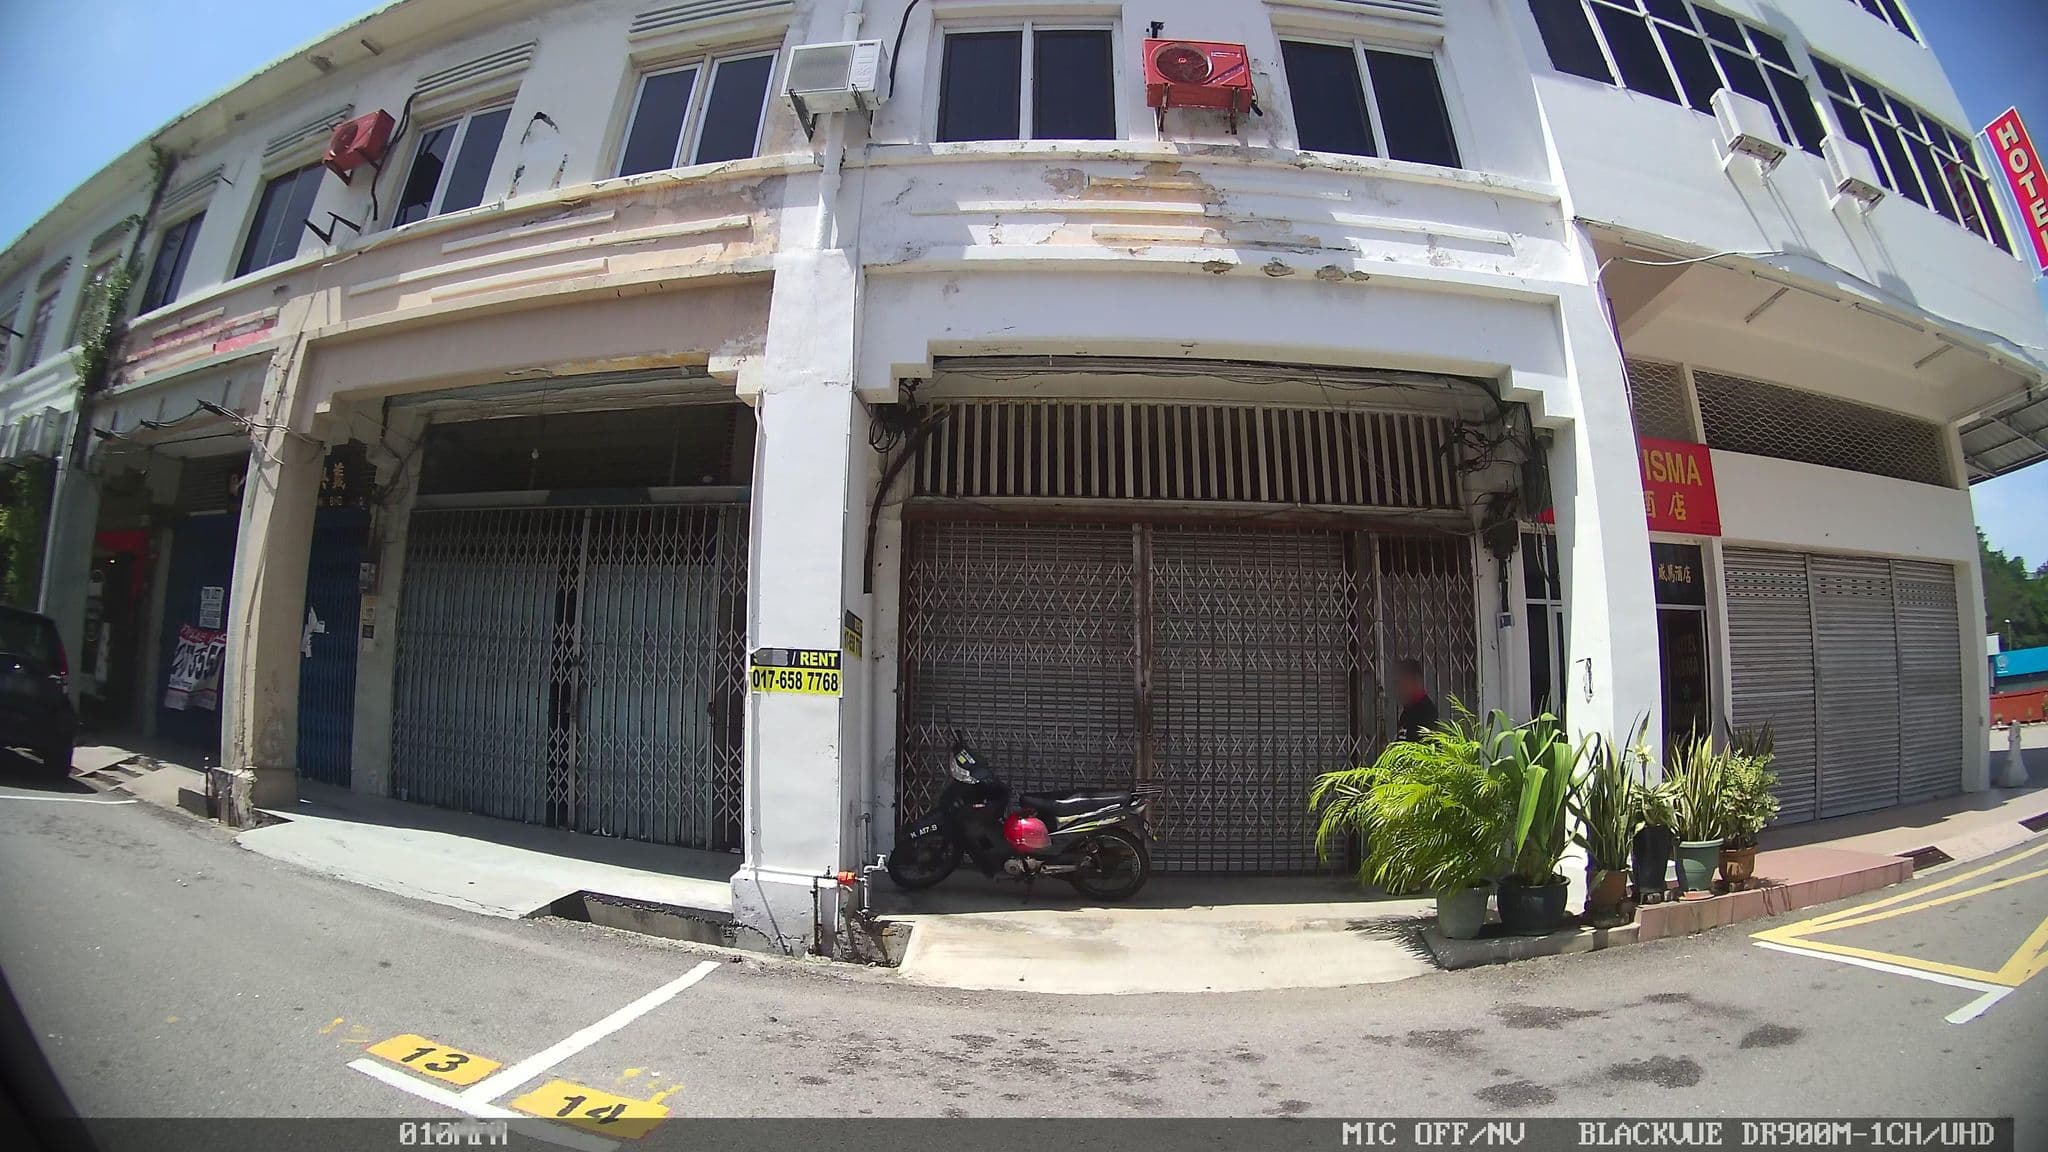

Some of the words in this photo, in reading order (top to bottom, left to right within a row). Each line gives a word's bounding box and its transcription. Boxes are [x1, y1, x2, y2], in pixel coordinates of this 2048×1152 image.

[800, 651, 838, 667] RENT
[752, 669, 803, 690] 017-658
[807, 672, 838, 692] 7768
[401, 1047, 471, 1072] 13
[555, 1095, 627, 1125] 14
